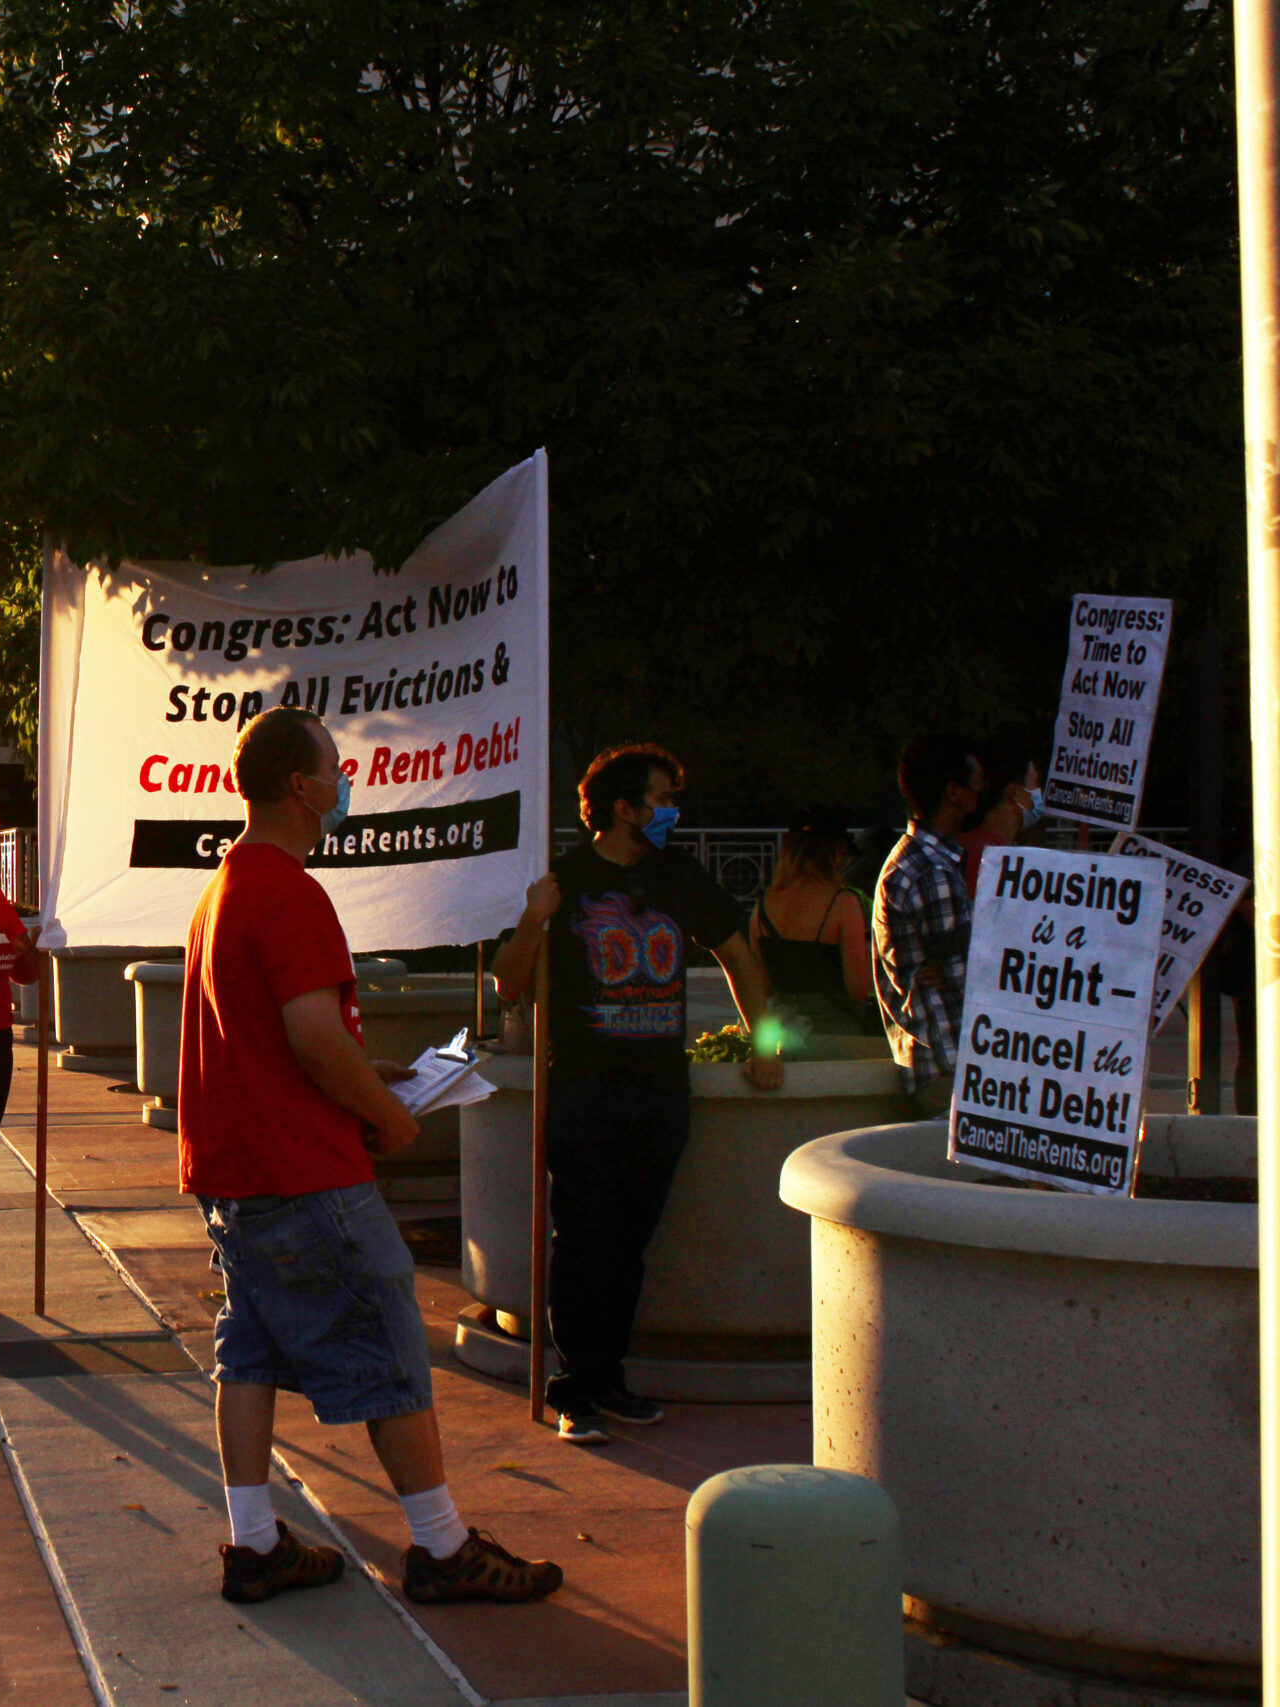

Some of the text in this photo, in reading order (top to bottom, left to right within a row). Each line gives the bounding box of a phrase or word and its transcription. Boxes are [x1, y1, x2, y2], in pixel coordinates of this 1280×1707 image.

[142, 564, 518, 662] Congress: Act Now to
[1075, 600, 1165, 635] Congress:
[1083, 634, 1147, 665] Time to
[166, 641, 510, 732] Stop All Evictions &
[1071, 668, 1146, 700] Act Now
[1068, 711, 1135, 748] Stop All
[367, 741, 447, 787] Rent
[453, 716, 521, 776] Debt!
[1054, 746, 1138, 786] Evictions!
[1047, 782, 1132, 823] CancelTheRents.org
[996, 855, 1142, 925] Housing
[1177, 891, 1204, 918] to
[1032, 914, 1087, 950] is a
[1162, 919, 1196, 944] ow
[999, 948, 1104, 1010] Right
[971, 1013, 1132, 1076] Cancel the
[962, 1063, 1131, 1134] Rent Debt!
[958, 1116, 1123, 1186] CancelTheRents.org
